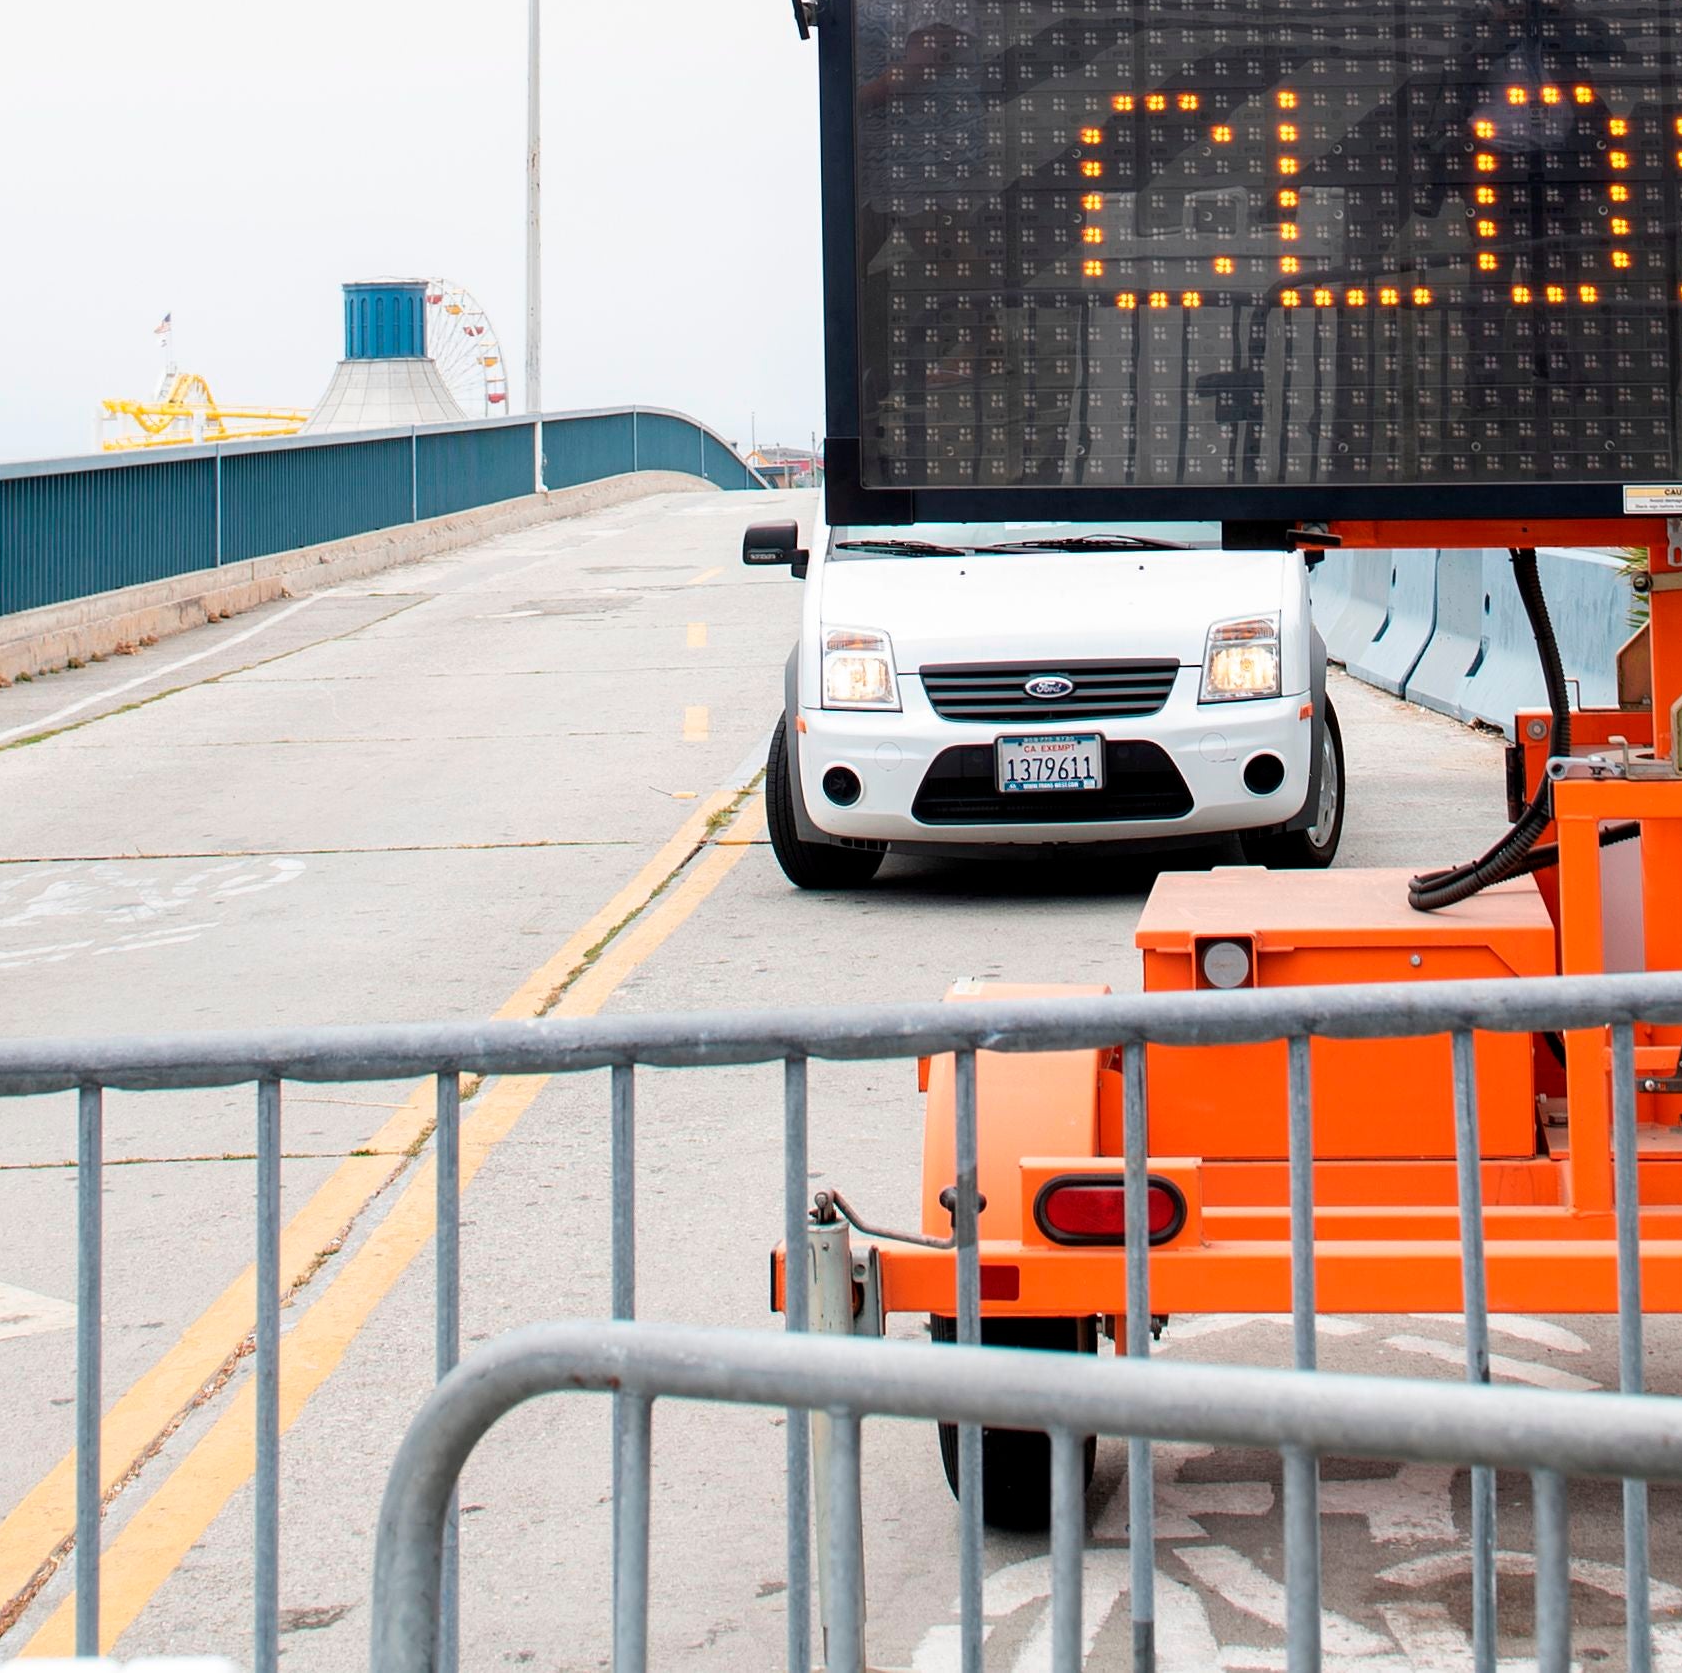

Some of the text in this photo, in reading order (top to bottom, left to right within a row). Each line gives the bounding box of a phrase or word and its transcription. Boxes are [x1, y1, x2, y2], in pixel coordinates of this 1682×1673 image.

[1024, 743, 1075, 753] CA EXEMPT
[1007, 756, 1095, 782] 1379611
